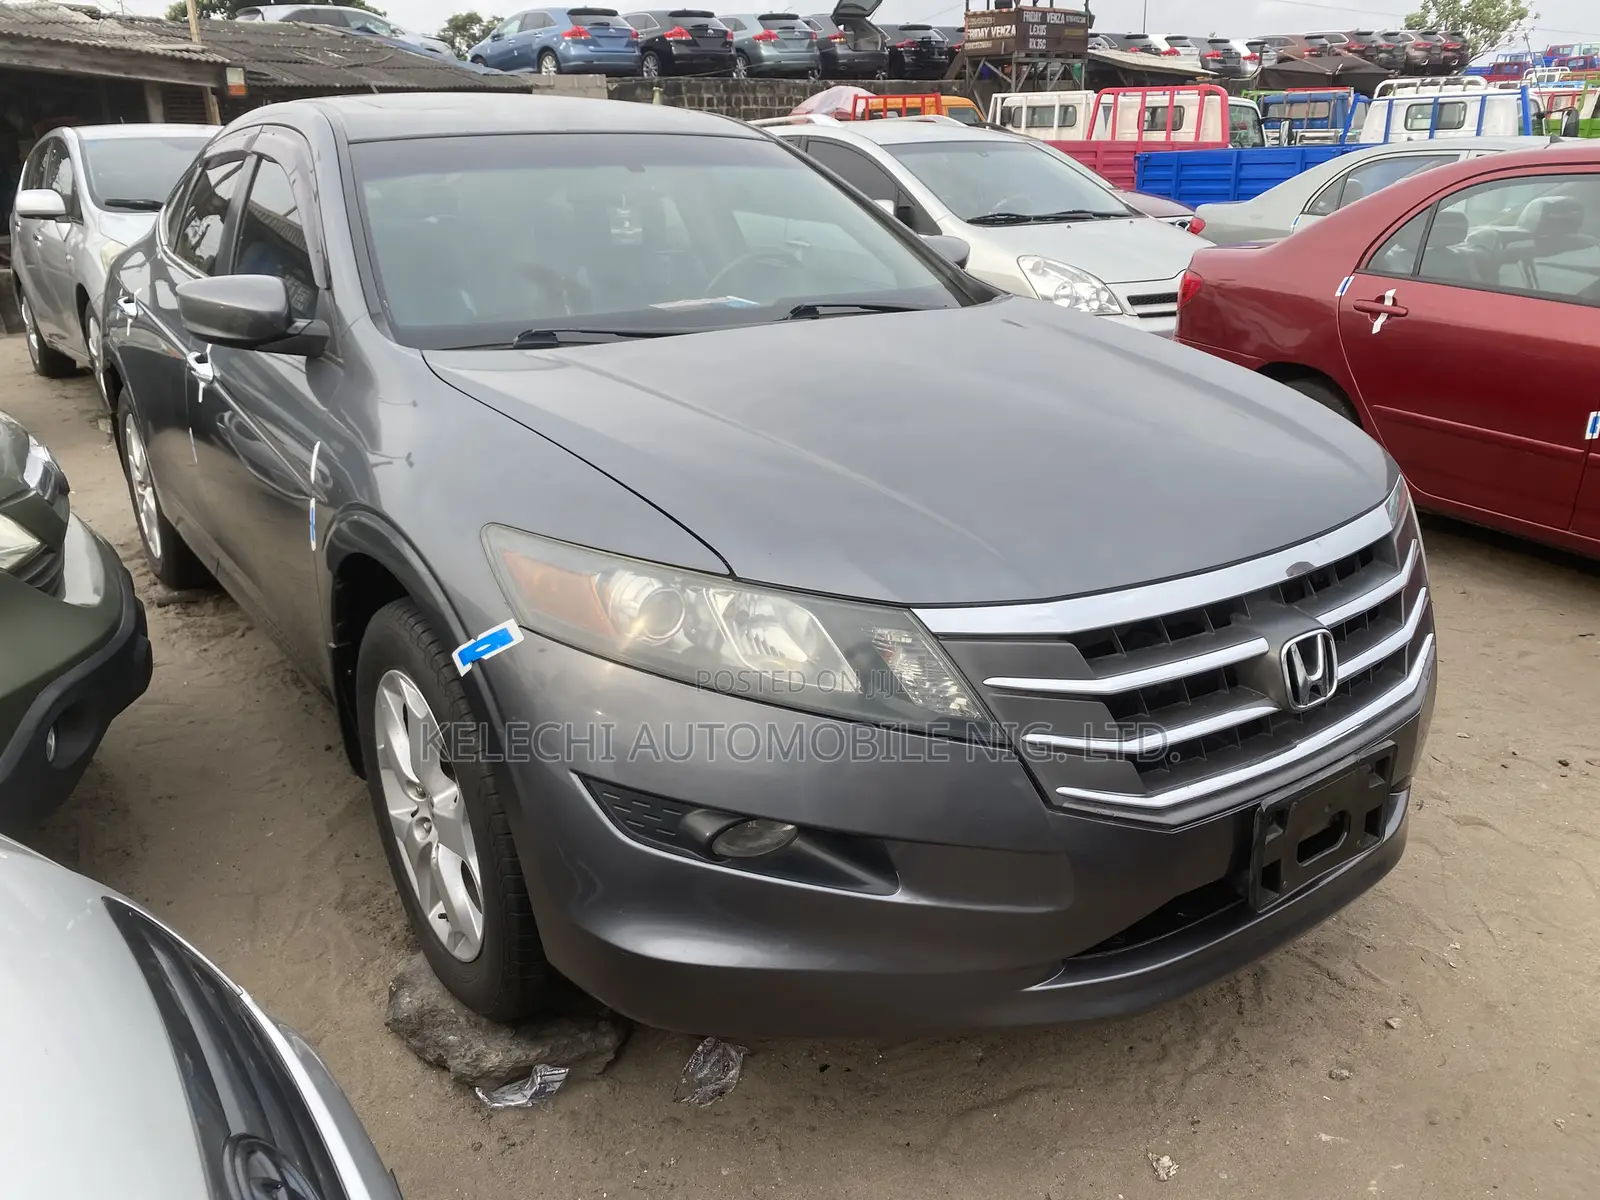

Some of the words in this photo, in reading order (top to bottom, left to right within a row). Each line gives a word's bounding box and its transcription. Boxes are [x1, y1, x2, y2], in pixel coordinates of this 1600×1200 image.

[1023, 11, 1042, 22] FRIDAY
[1047, 12, 1065, 24] VENZA
[968, 27, 990, 40] FRIDAY
[991, 24, 1016, 38] VENZA
[1029, 24, 1047, 35] LEXUS
